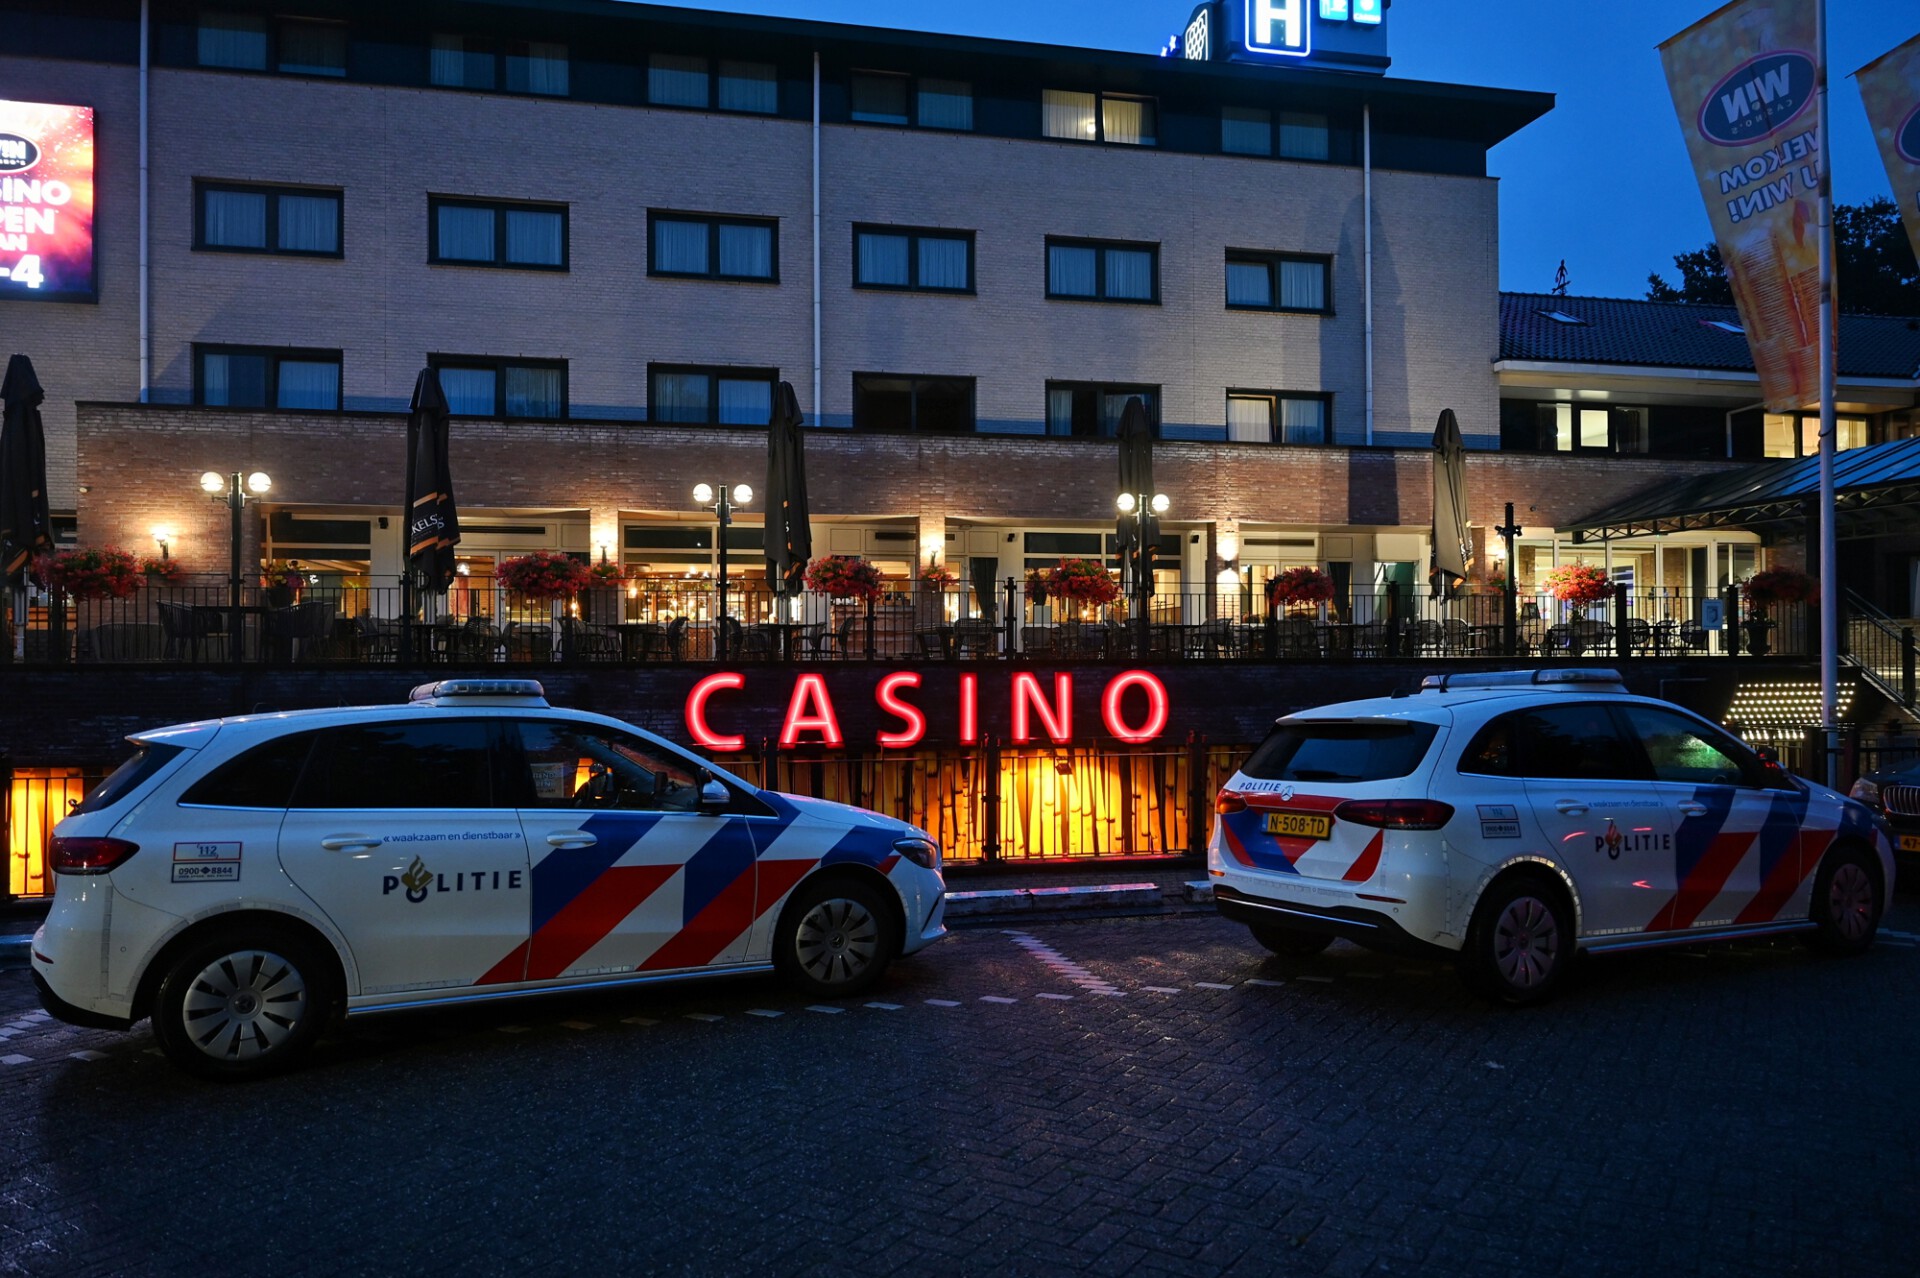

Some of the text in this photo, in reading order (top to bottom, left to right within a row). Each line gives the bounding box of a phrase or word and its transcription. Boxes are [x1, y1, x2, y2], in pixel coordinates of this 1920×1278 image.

[1256, 0, 1300, 47] H
[0, 139, 27, 159] IN
[0, 177, 72, 205] INO
[0, 205, 55, 235] EN
[684, 669, 1171, 752] CASINO
[1239, 782, 1281, 792] POLITIE
[392, 832, 447, 843] waakzaam
[447, 833, 461, 841] en
[462, 831, 513, 841] dienstbaar
[1269, 815, 1326, 835] N-508-TD
[199, 844, 218, 856] 112
[1594, 833, 1671, 861] POLITIE
[382, 869, 522, 904] POLITIE
